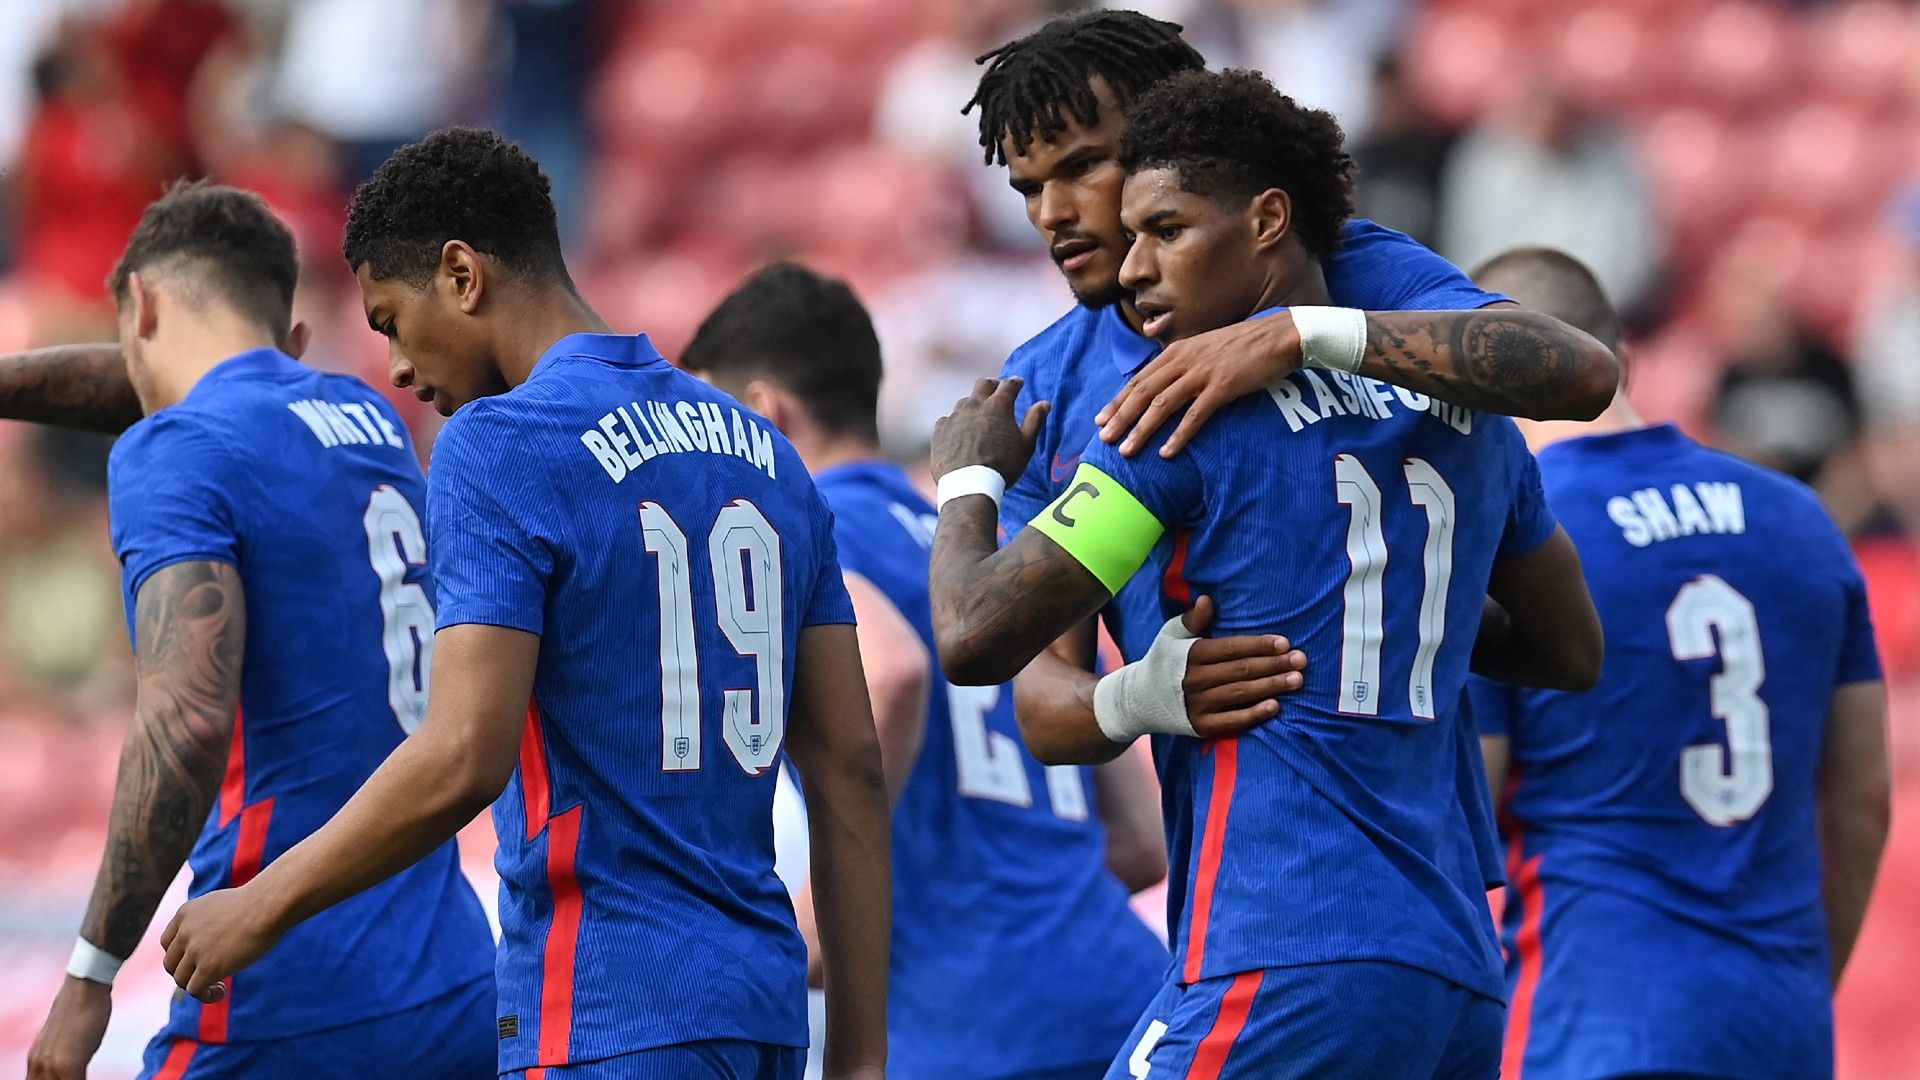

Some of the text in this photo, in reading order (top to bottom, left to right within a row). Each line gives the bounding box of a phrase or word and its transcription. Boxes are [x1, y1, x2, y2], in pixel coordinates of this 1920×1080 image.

[287, 399, 404, 449] WHITE
[580, 400, 776, 484] BELLINGHAM
[1052, 482, 1100, 527] C
[1334, 453, 1456, 719] 11
[1606, 481, 1746, 548] SHAW
[363, 484, 436, 737] 6
[639, 498, 783, 775] 19
[1664, 573, 1774, 827] 3
